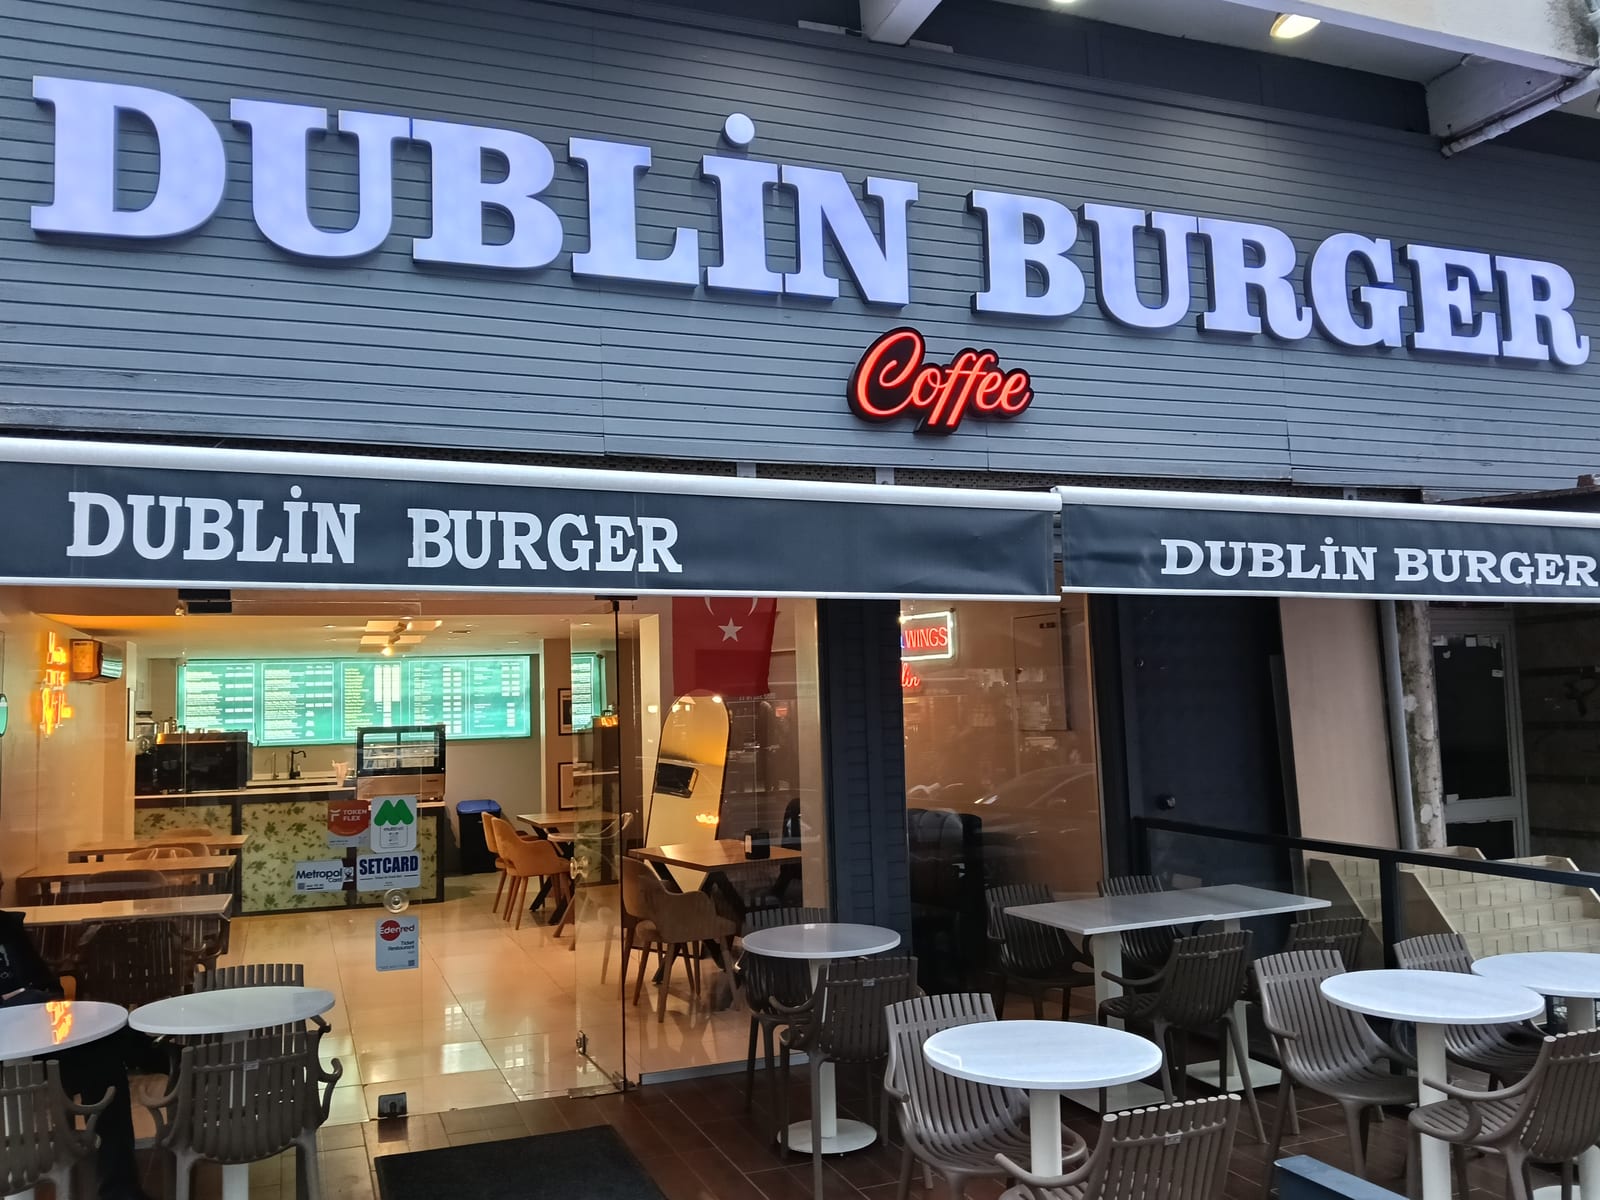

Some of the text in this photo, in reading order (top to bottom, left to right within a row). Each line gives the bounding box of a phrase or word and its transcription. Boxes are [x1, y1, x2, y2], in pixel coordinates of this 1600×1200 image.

[31, 76, 1591, 366] DUBLİN BURGER
[855, 330, 1031, 427] Coffee
[66, 486, 683, 574] DUBLİN BURGER
[1160, 536, 1599, 587] DUBLİN BURGER
[904, 627, 948, 648] WINGS
[295, 868, 343, 880] Metropol
[359, 855, 419, 875] SETCARD
[380, 925, 415, 935] Edenred
